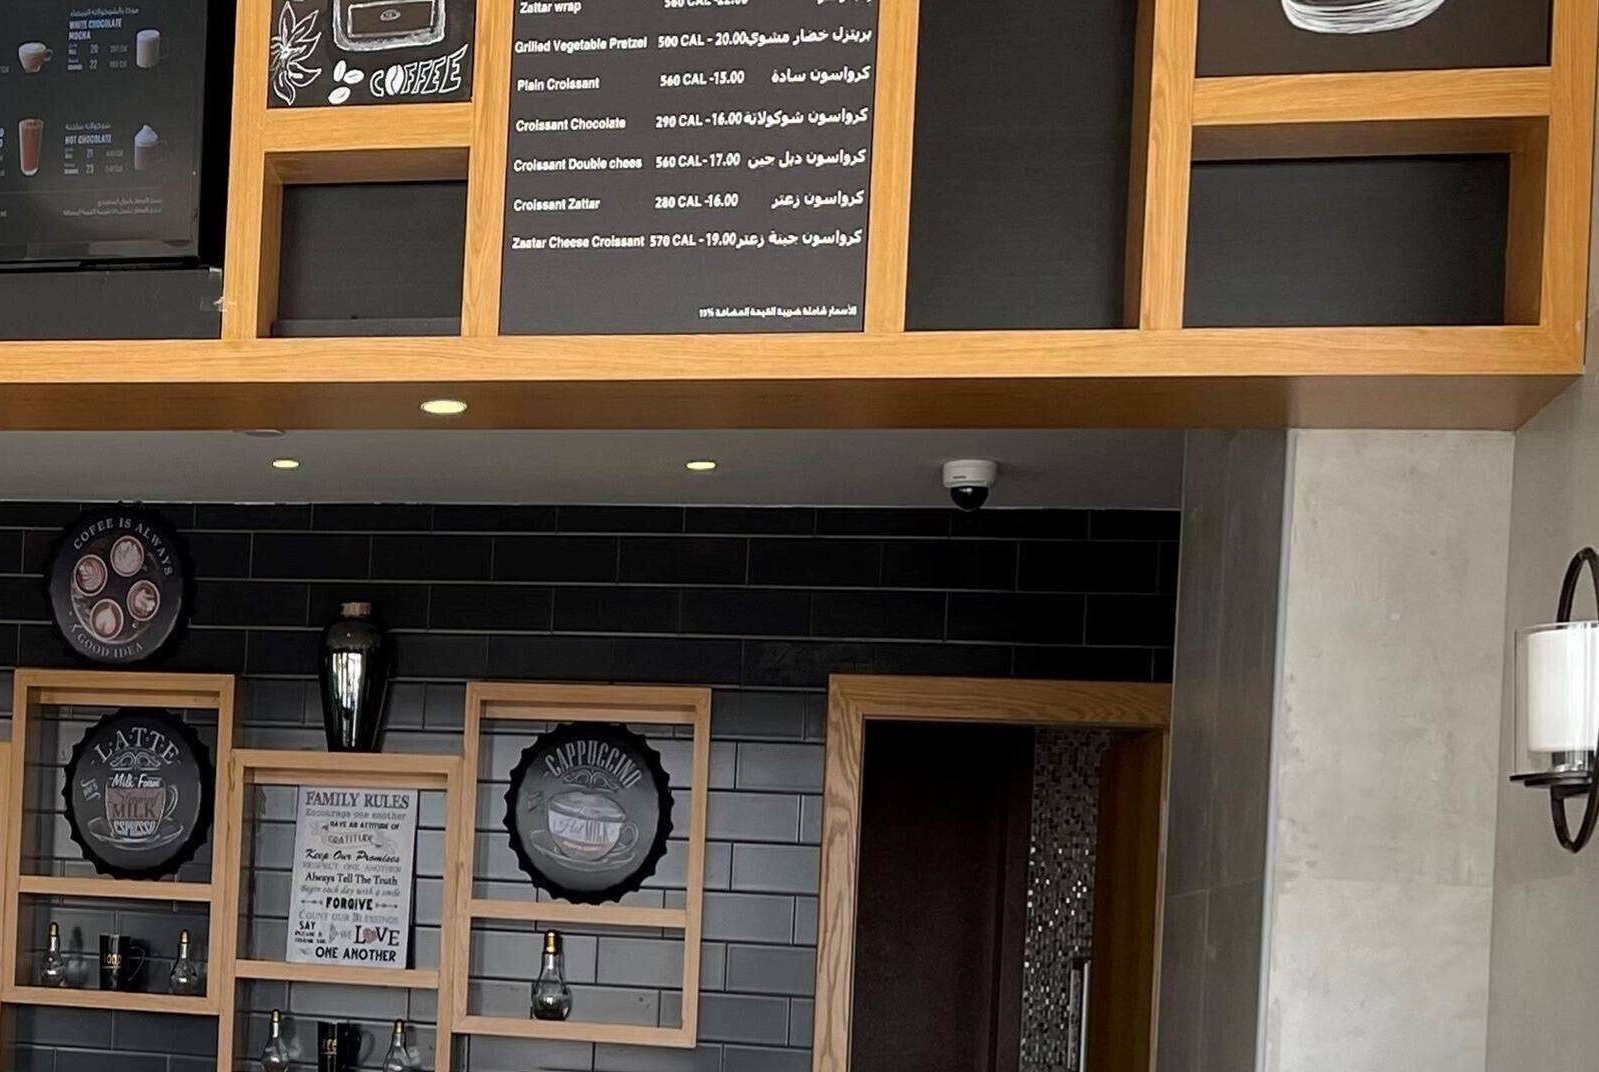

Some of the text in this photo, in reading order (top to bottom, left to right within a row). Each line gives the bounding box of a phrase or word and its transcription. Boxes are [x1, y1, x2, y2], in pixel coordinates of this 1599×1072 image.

[515, 37, 647, 53] Grilled Vegetable Pretzel
[658, 36, 678, 48] 500
[681, 34, 704, 46] CAL
[518, 78, 599, 91] Plain Croissant
[683, 73, 707, 85] CAL
[516, 117, 626, 131] Croissant Chocolate
[679, 115, 703, 126] CAL
[514, 159, 566, 172] Croissant
[569, 157, 607, 169] Double
[710, 153, 740, 166] 17.00
[514, 199, 566, 211] Croissant
[678, 196, 702, 208] CAL
[549, 236, 589, 248] Cheese
[592, 235, 645, 247] Croissant
[672, 234, 696, 246] CAL
[119, 517, 132, 528] IS
[134, 523, 174, 576] ALWAYS
[77, 633, 109, 657] GOOD
[545, 740, 642, 789] CAPPUCCINO
[306, 791, 410, 810] FAMILY RULES
[113, 803, 155, 818] MILK
[305, 872, 398, 886] Always Tell The Truth
[326, 896, 373, 910] FORGIVE
[299, 921, 316, 930] SAY
[315, 946, 396, 962] ONE ANOTHER
